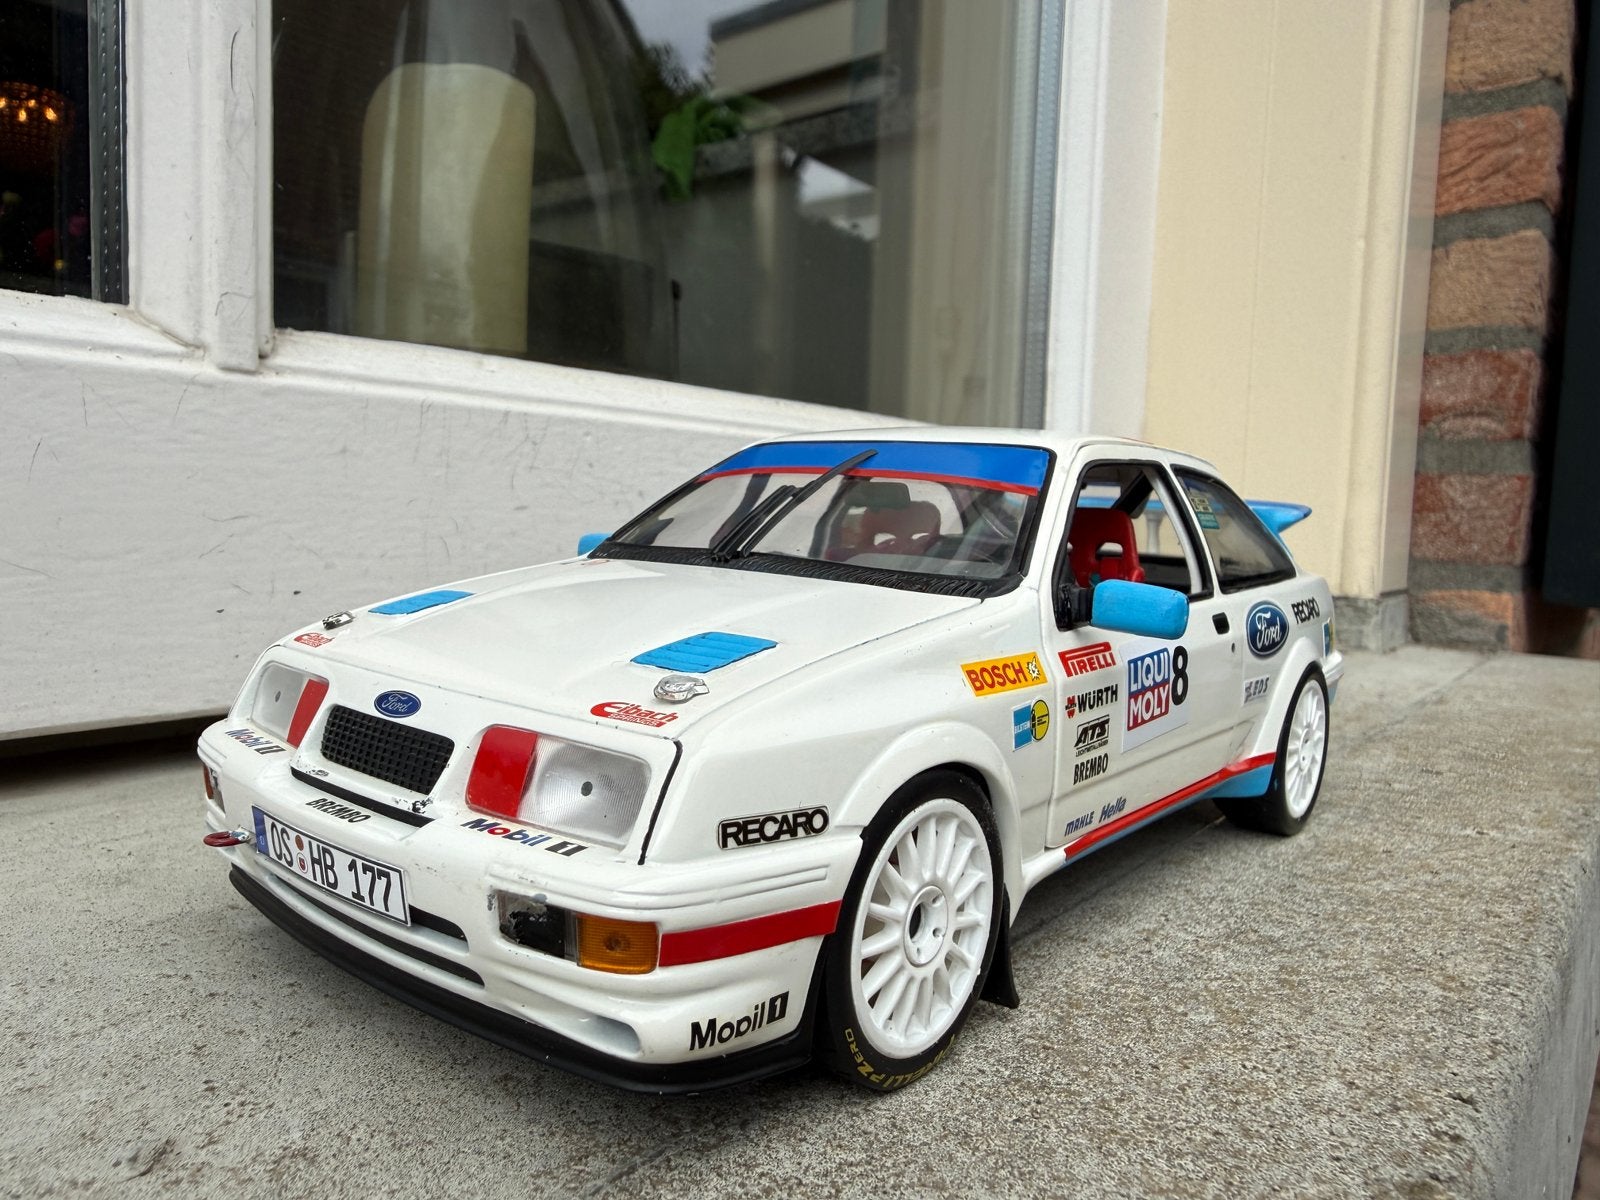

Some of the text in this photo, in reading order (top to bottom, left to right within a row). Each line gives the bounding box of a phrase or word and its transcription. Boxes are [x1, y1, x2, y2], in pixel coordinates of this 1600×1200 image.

[1291, 597, 1320, 624] RECARO
[1255, 611, 1282, 649] Ford
[1058, 642, 1117, 678] PIRELLI
[1130, 651, 1169, 692] LIQUI
[1171, 645, 1188, 706] 8
[965, 661, 1028, 692] BOSCH
[382, 693, 413, 712] Ford
[590, 701, 679, 723] Eibach
[1077, 684, 1119, 713] WÜRTH
[1129, 684, 1169, 727] MOLY
[1074, 718, 1110, 748] ATS
[1073, 753, 1109, 785] BREMBO
[306, 798, 372, 823] BREMBO
[1064, 811, 1095, 837] MAHLE
[460, 817, 552, 847] Mobil
[721, 808, 829, 848] RECARO
[270, 821, 392, 913] OS HB 177
